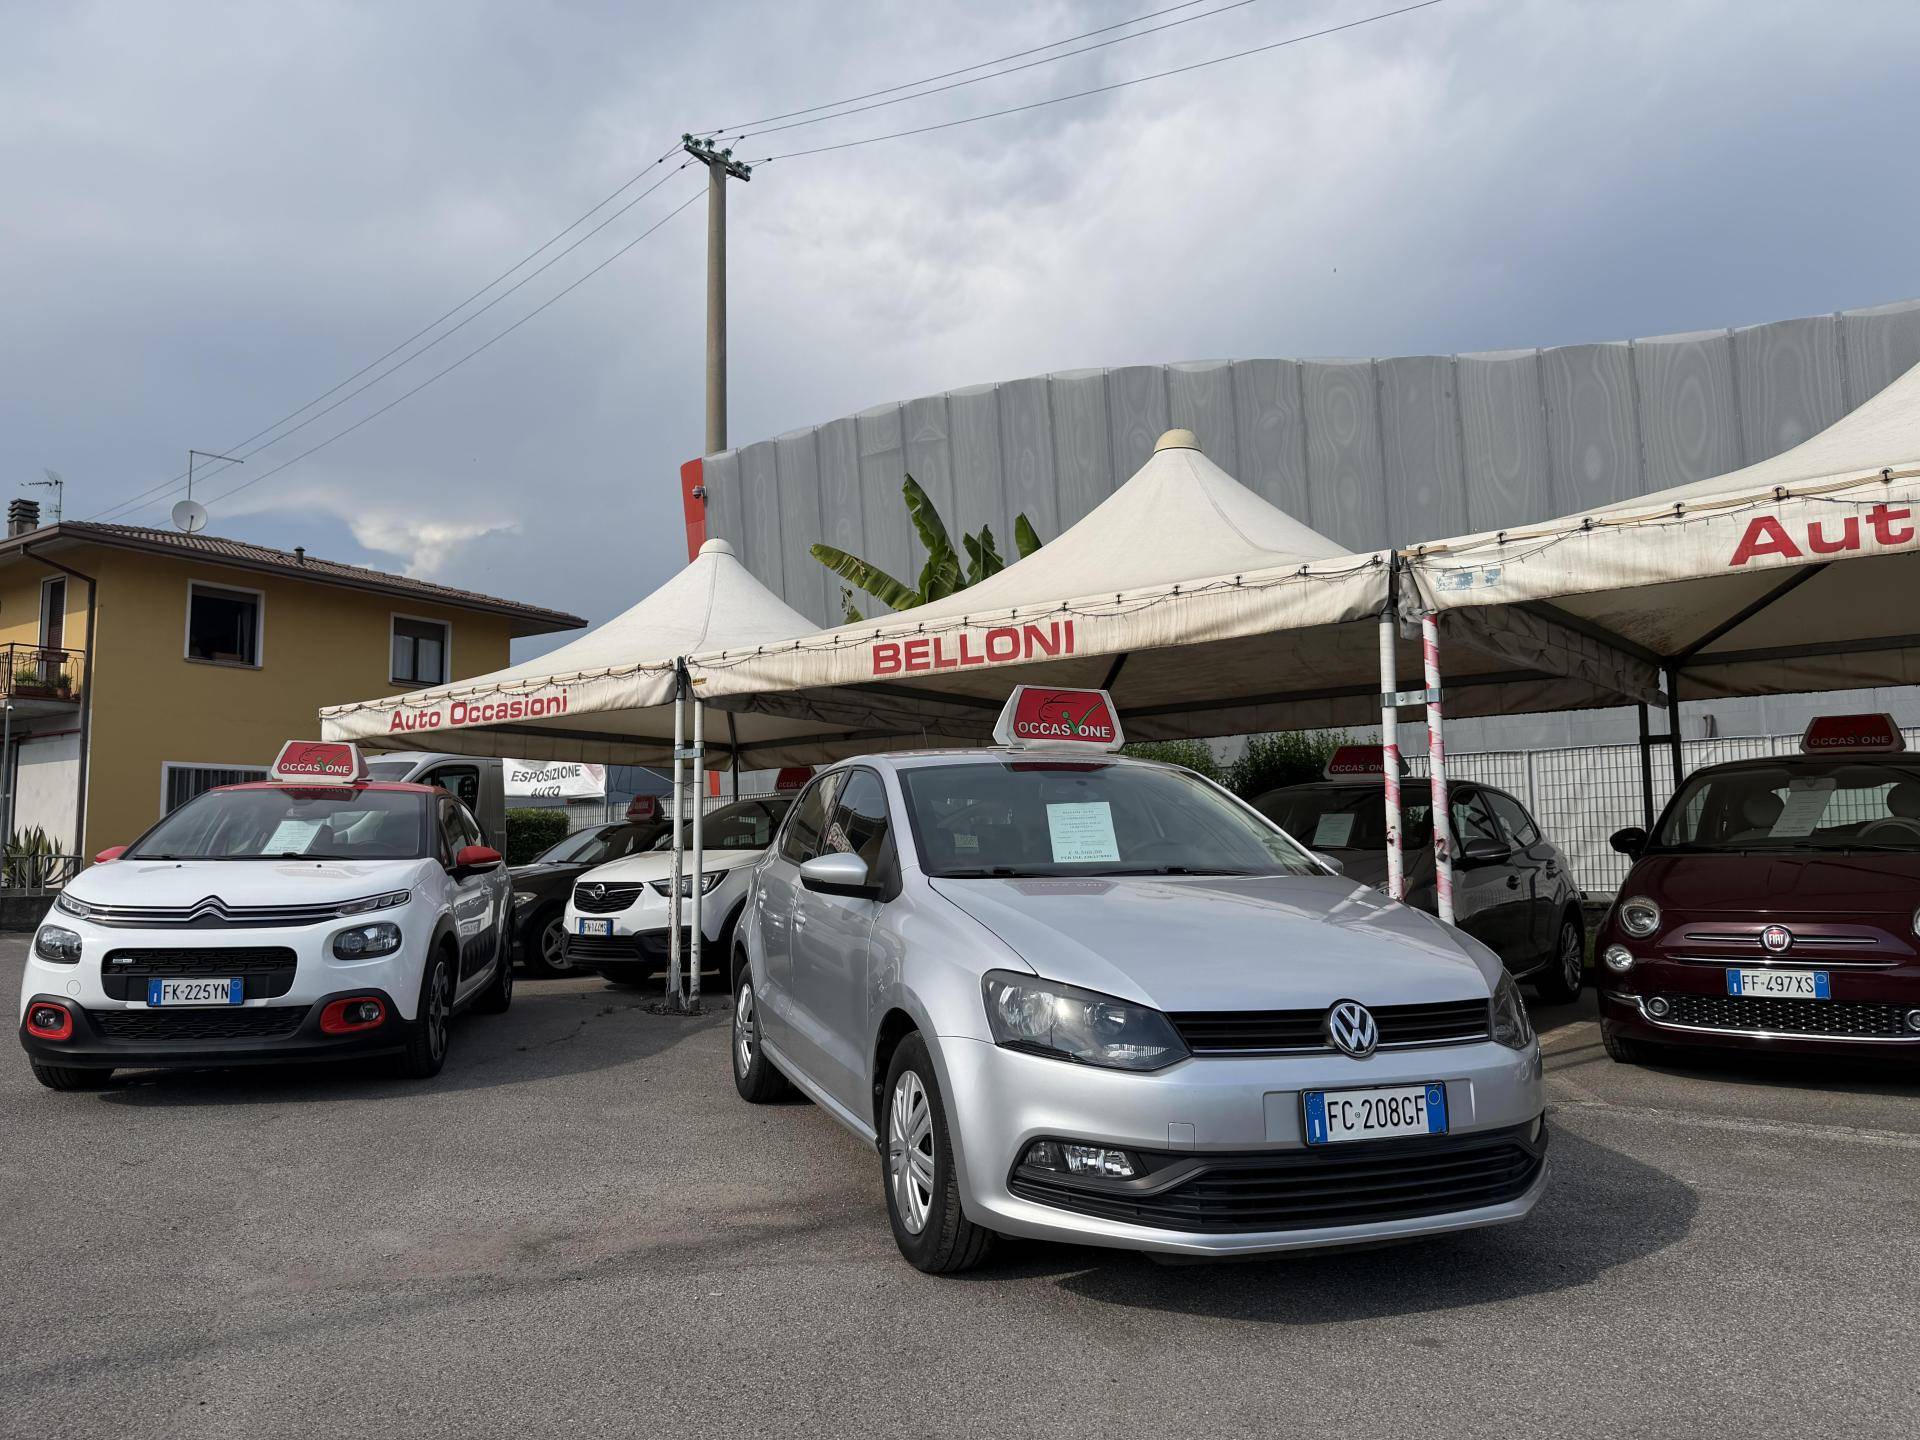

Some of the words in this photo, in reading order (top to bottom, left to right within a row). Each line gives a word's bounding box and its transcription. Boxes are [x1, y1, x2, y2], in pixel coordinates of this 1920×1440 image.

[1728, 504, 1915, 566] Aut
[872, 620, 1075, 675] BELLONI
[389, 709, 441, 732] Auto
[450, 688, 568, 725] Occasioni
[1810, 735, 1890, 746] OCCASONE
[511, 764, 582, 783] ESPOSIZIONE
[530, 785, 561, 798] AUTO
[1768, 933, 1784, 945] FIAT
